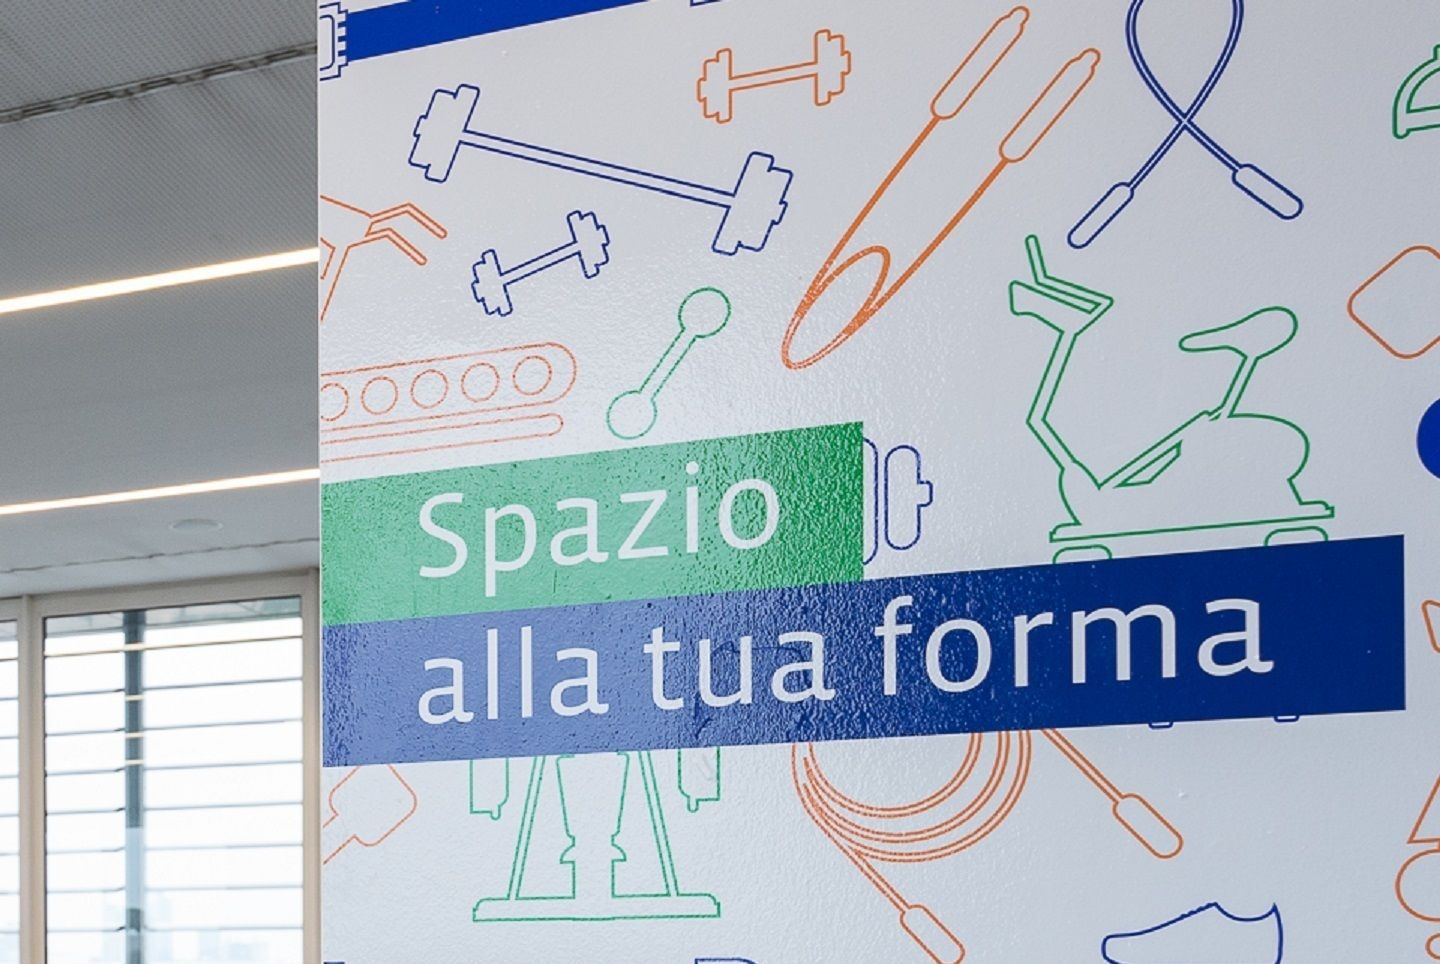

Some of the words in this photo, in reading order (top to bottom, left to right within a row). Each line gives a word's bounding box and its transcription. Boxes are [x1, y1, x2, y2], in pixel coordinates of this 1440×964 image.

[417, 462, 781, 597] Spazio
[417, 625, 611, 726] alla
[643, 625, 837, 711] tua
[873, 593, 1274, 697] forma
